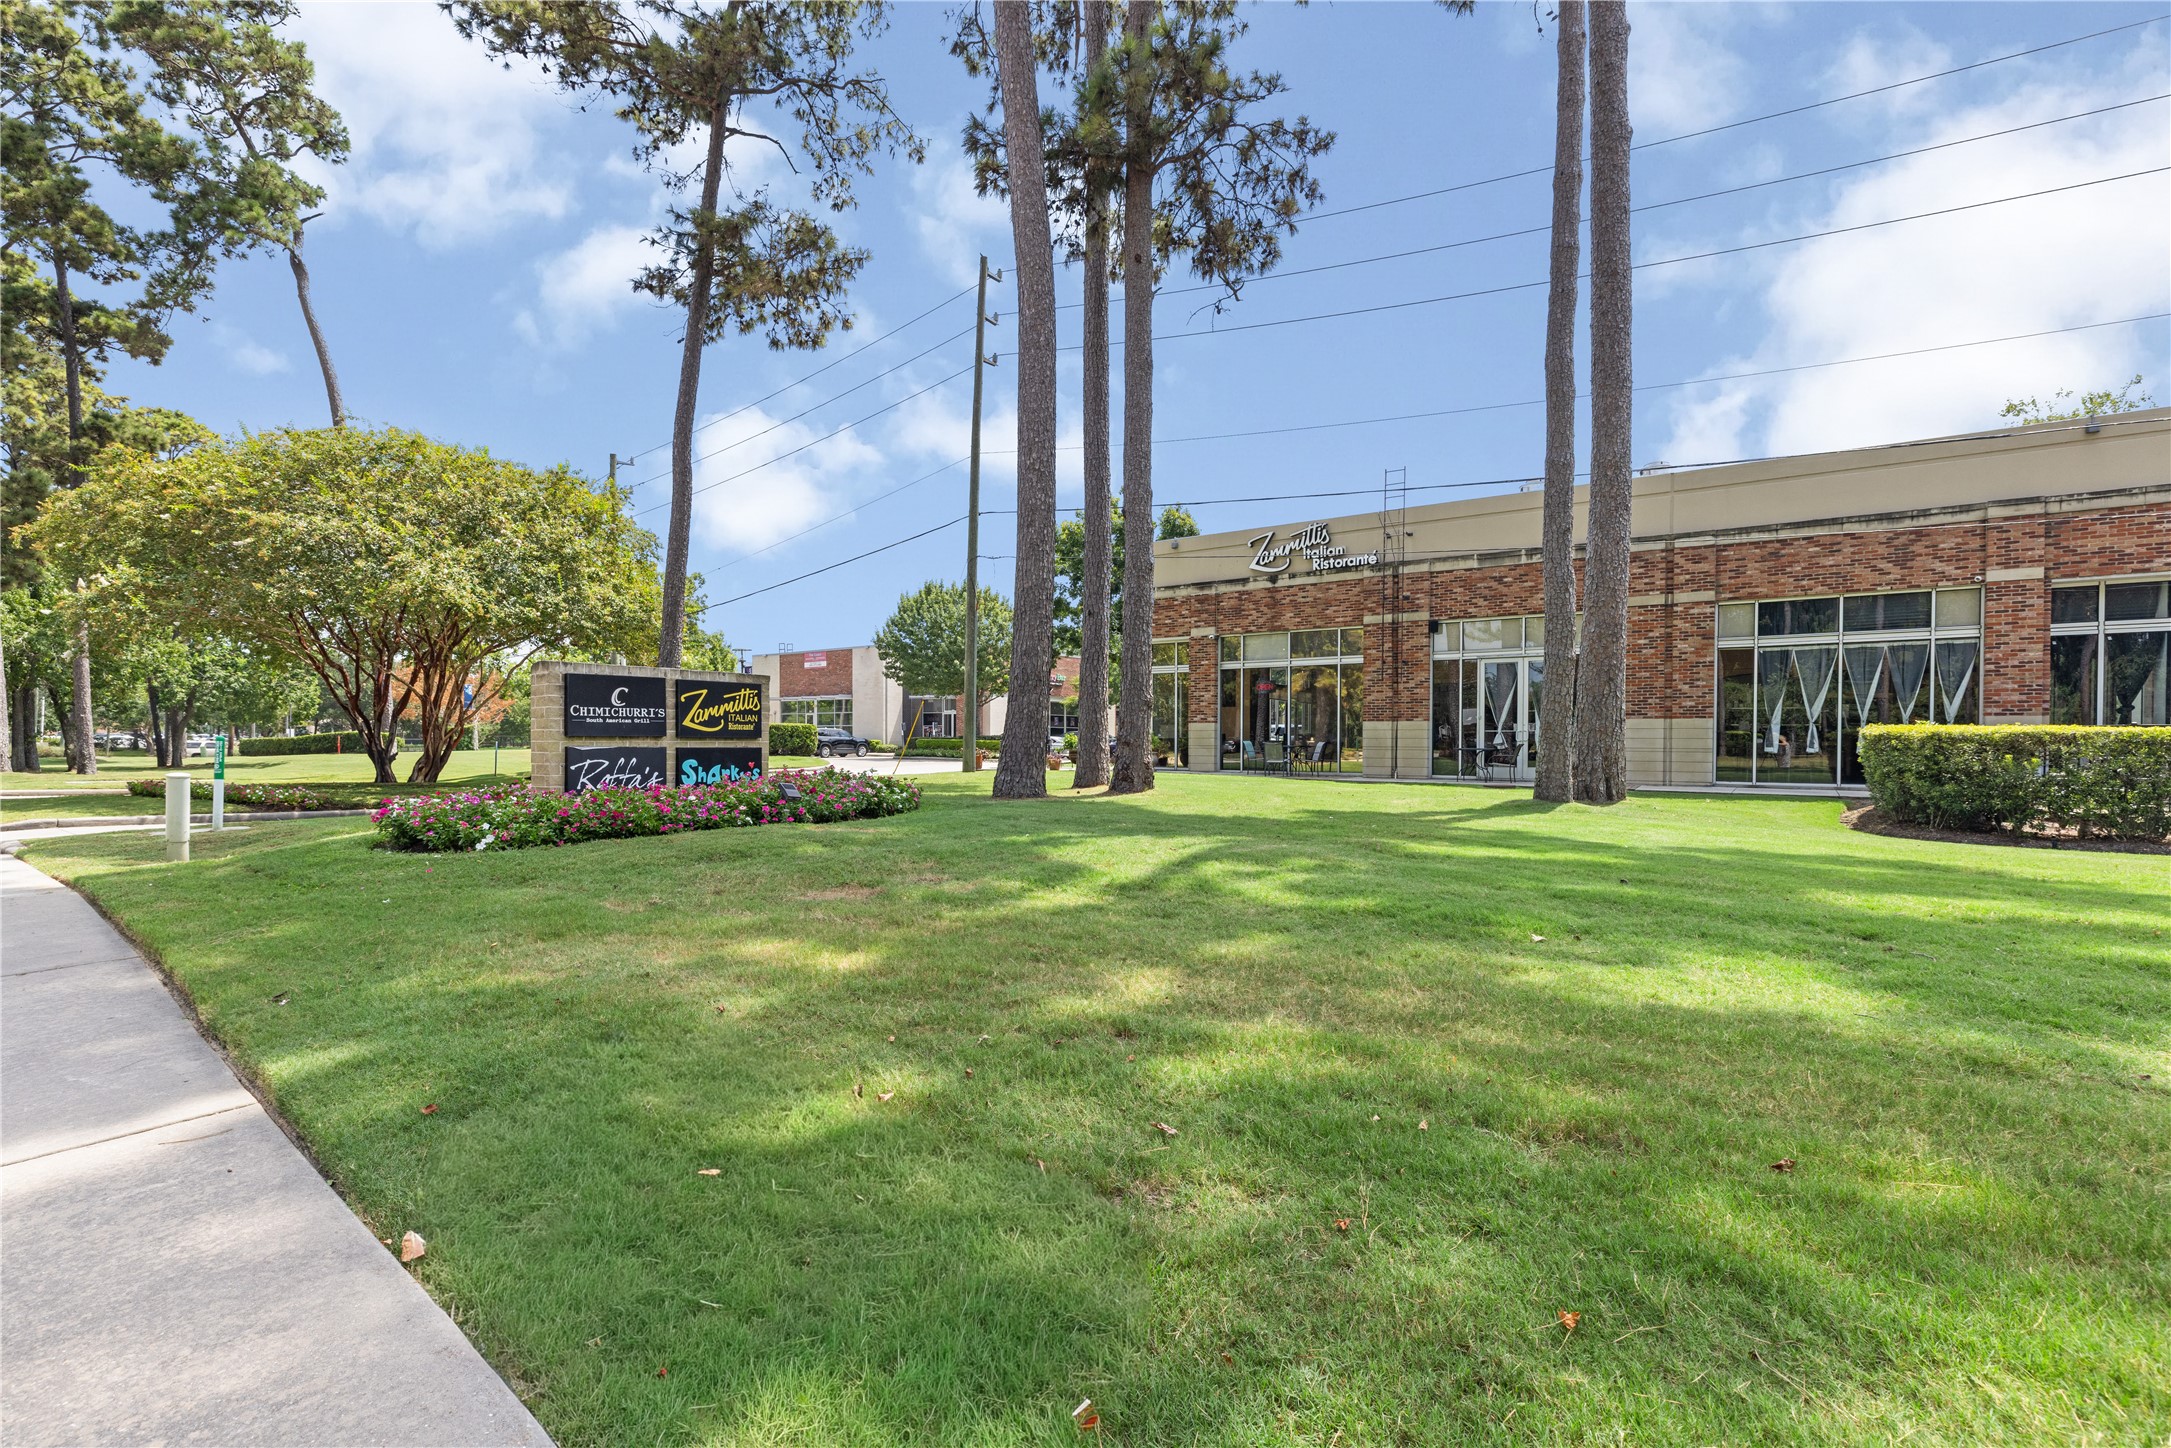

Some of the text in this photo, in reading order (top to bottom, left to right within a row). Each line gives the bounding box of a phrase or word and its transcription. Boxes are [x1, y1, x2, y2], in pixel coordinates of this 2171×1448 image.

[1303, 545, 1345, 560] Italian
[570, 705, 666, 718] CHIMICHURRI'S
[728, 713, 758, 722] ITALIAN
